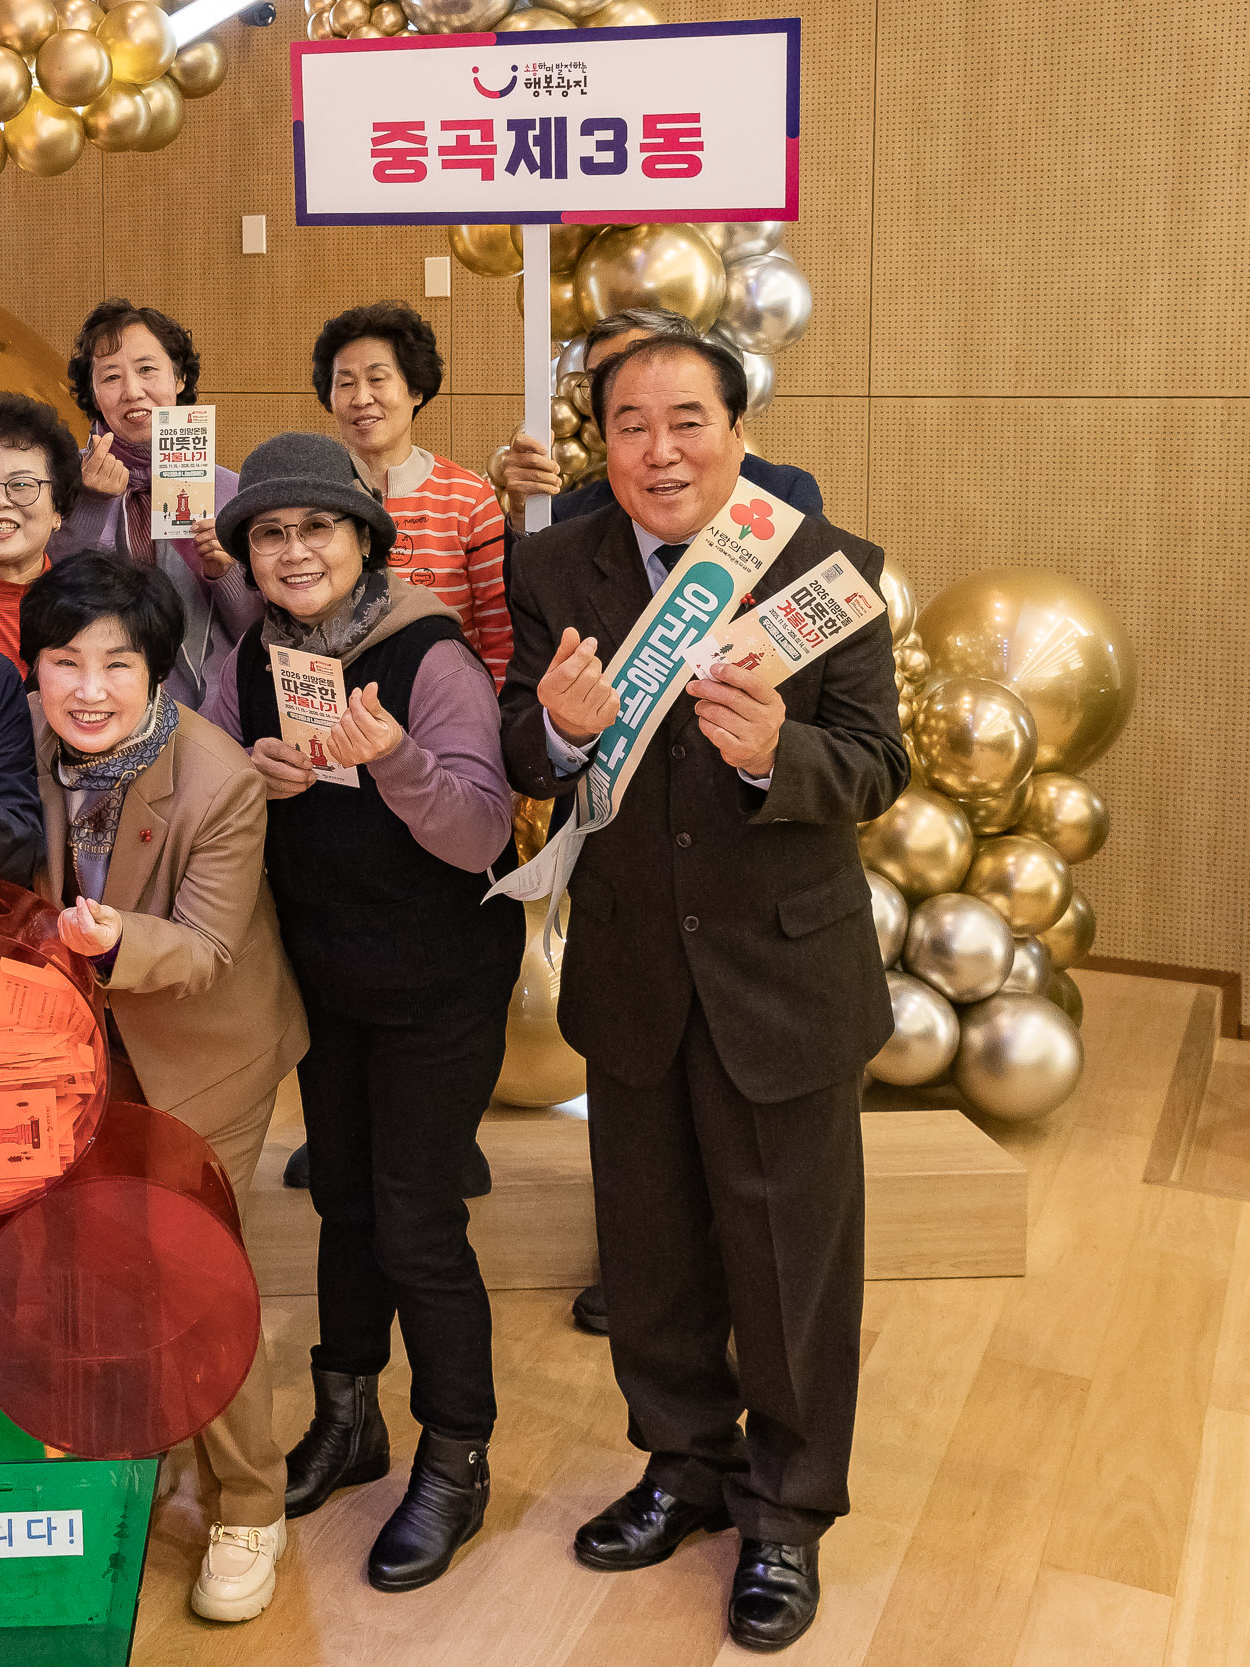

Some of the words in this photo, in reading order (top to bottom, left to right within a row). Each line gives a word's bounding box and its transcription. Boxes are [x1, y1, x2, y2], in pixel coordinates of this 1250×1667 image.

[524, 62, 554, 76] 소통하며
[555, 61, 587, 75] 발전하는
[524, 74, 588, 98] 행복광진
[370, 112, 704, 184] 중곡제3동
[159, 436, 208, 451] 따뜻한
[159, 451, 207, 462] 겨울나기
[707, 526, 763, 570] 사랑의열매
[809, 580, 829, 600] 2026
[777, 600, 824, 648] 겨울나기
[791, 587, 842, 639] 따뜻한
[281, 678, 337, 702] 따뜻한
[283, 693, 338, 714] 겨울나기
